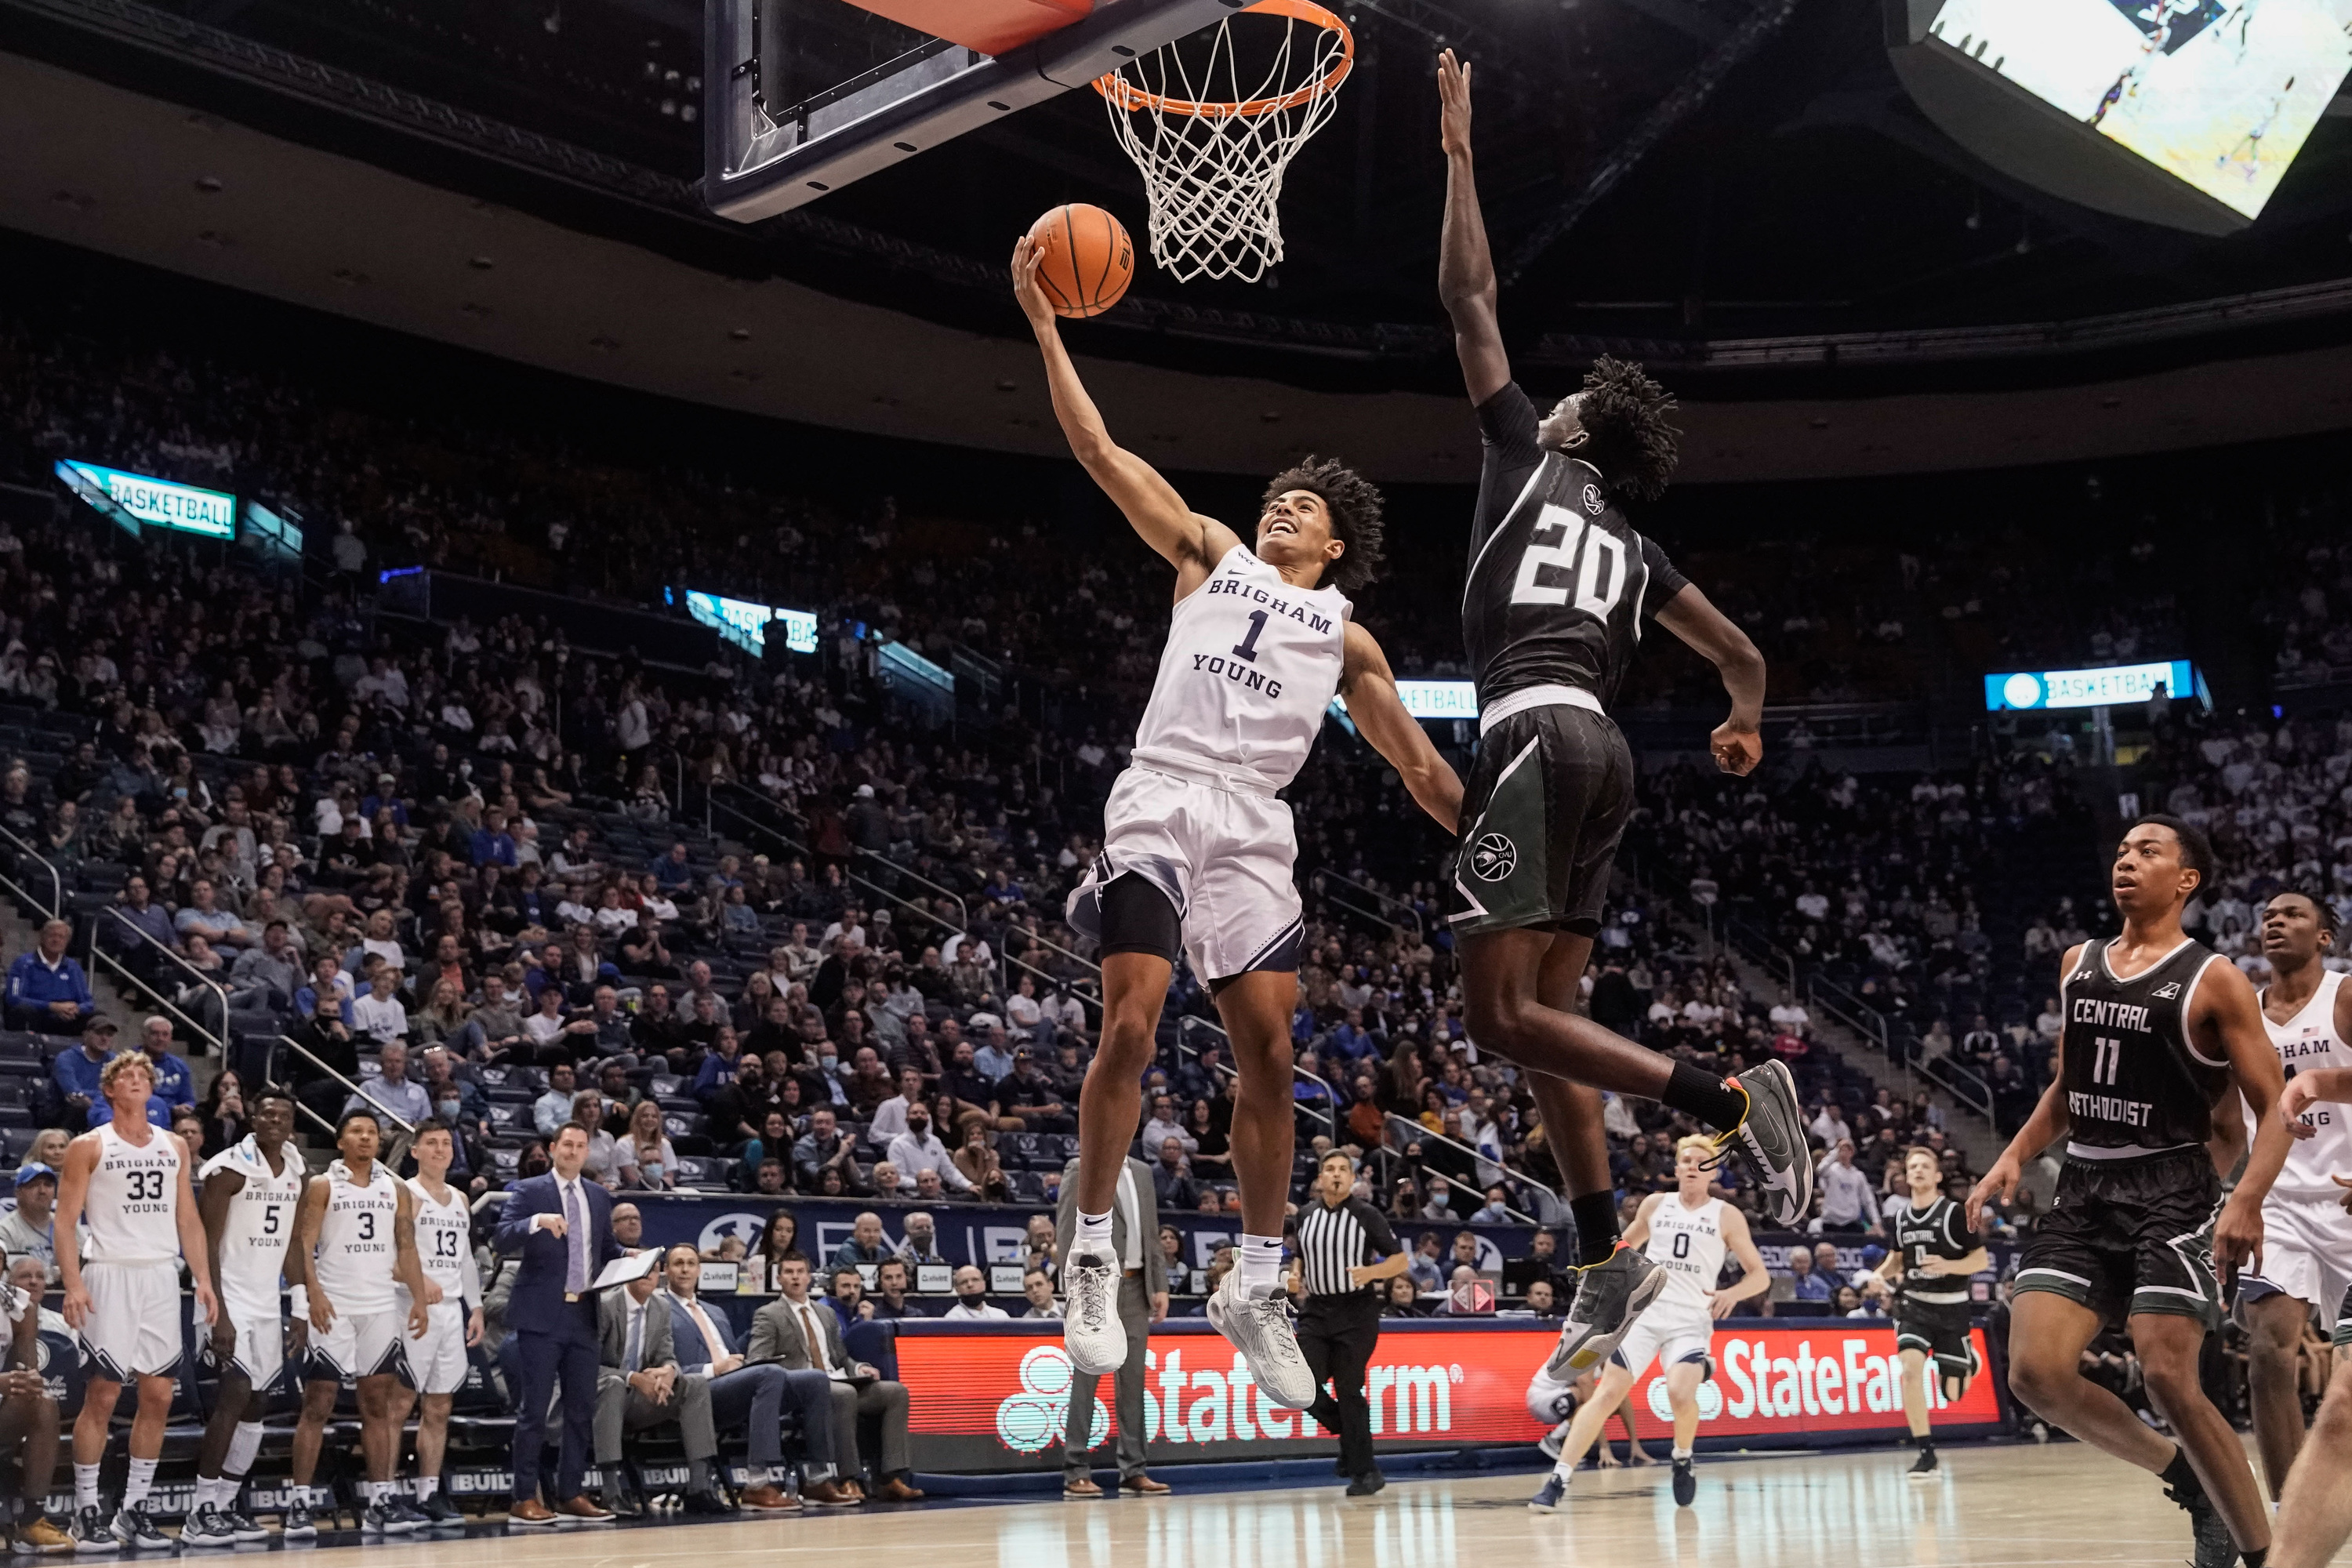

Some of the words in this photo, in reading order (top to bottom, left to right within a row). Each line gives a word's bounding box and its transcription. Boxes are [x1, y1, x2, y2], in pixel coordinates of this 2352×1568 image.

[111, 483, 231, 526] BASKETBALL
[1510, 502, 1625, 626] 20
[1208, 579, 1332, 635] BRIGHAM
[1232, 609, 1269, 663] 1
[1193, 654, 1282, 699] YOUNG
[1498, 850, 1512, 859] CMU
[2073, 998, 2151, 1033] CENTRAL
[2093, 1037, 2120, 1085] 11
[105, 1159, 177, 1171] BRIGHAM
[126, 1171, 164, 1200] 33
[122, 1203, 169, 1214] YOUNG
[264, 1206, 280, 1234] 5
[358, 1213, 374, 1240] 3
[1656, 1219, 1716, 1236] BRIGHAM
[436, 1230, 457, 1257] 13
[1673, 1232, 1690, 1259] 0
